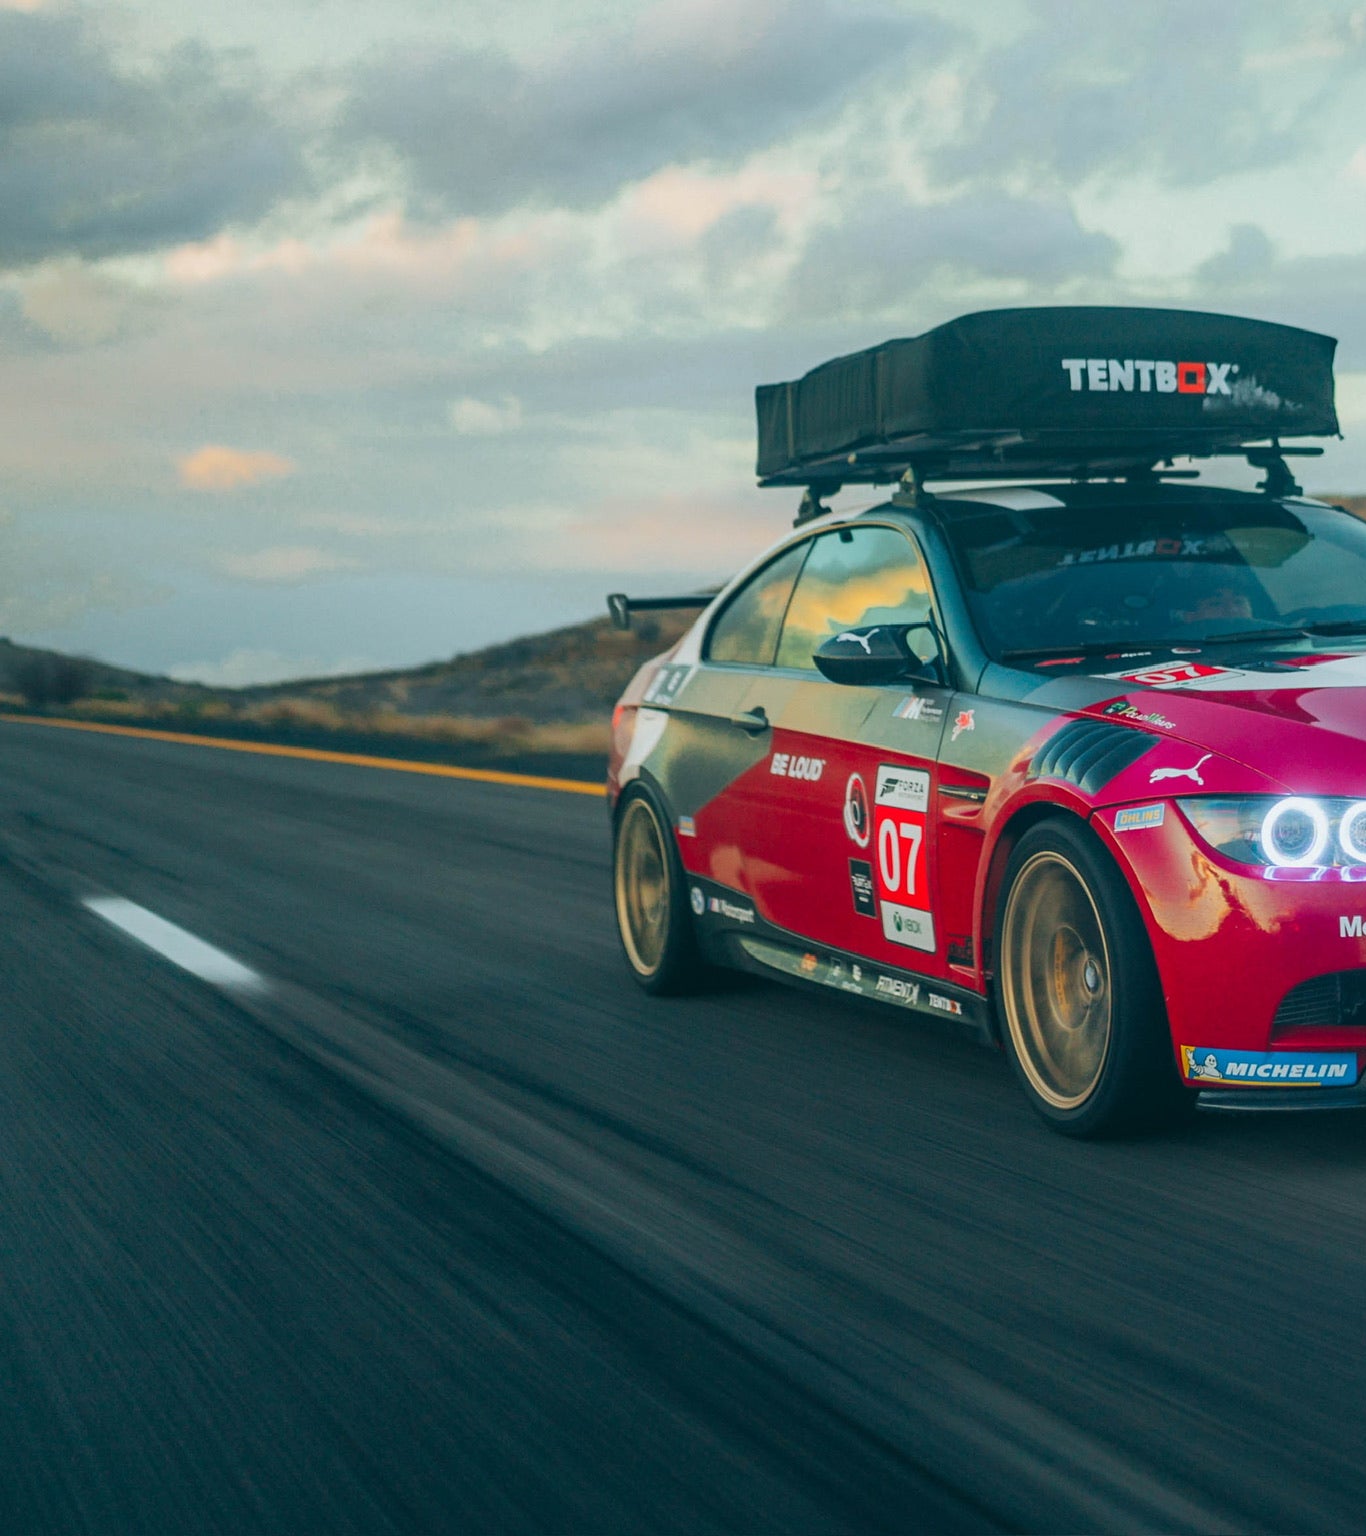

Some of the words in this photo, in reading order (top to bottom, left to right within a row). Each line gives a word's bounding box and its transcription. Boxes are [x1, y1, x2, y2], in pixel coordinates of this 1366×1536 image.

[1062, 359, 1233, 395] TENTBOX
[1134, 665, 1202, 683] 07
[770, 753, 790, 776] BE
[788, 755, 823, 781] LOUD
[878, 818, 922, 895] 07
[1225, 1062, 1348, 1078] MICHELIN
